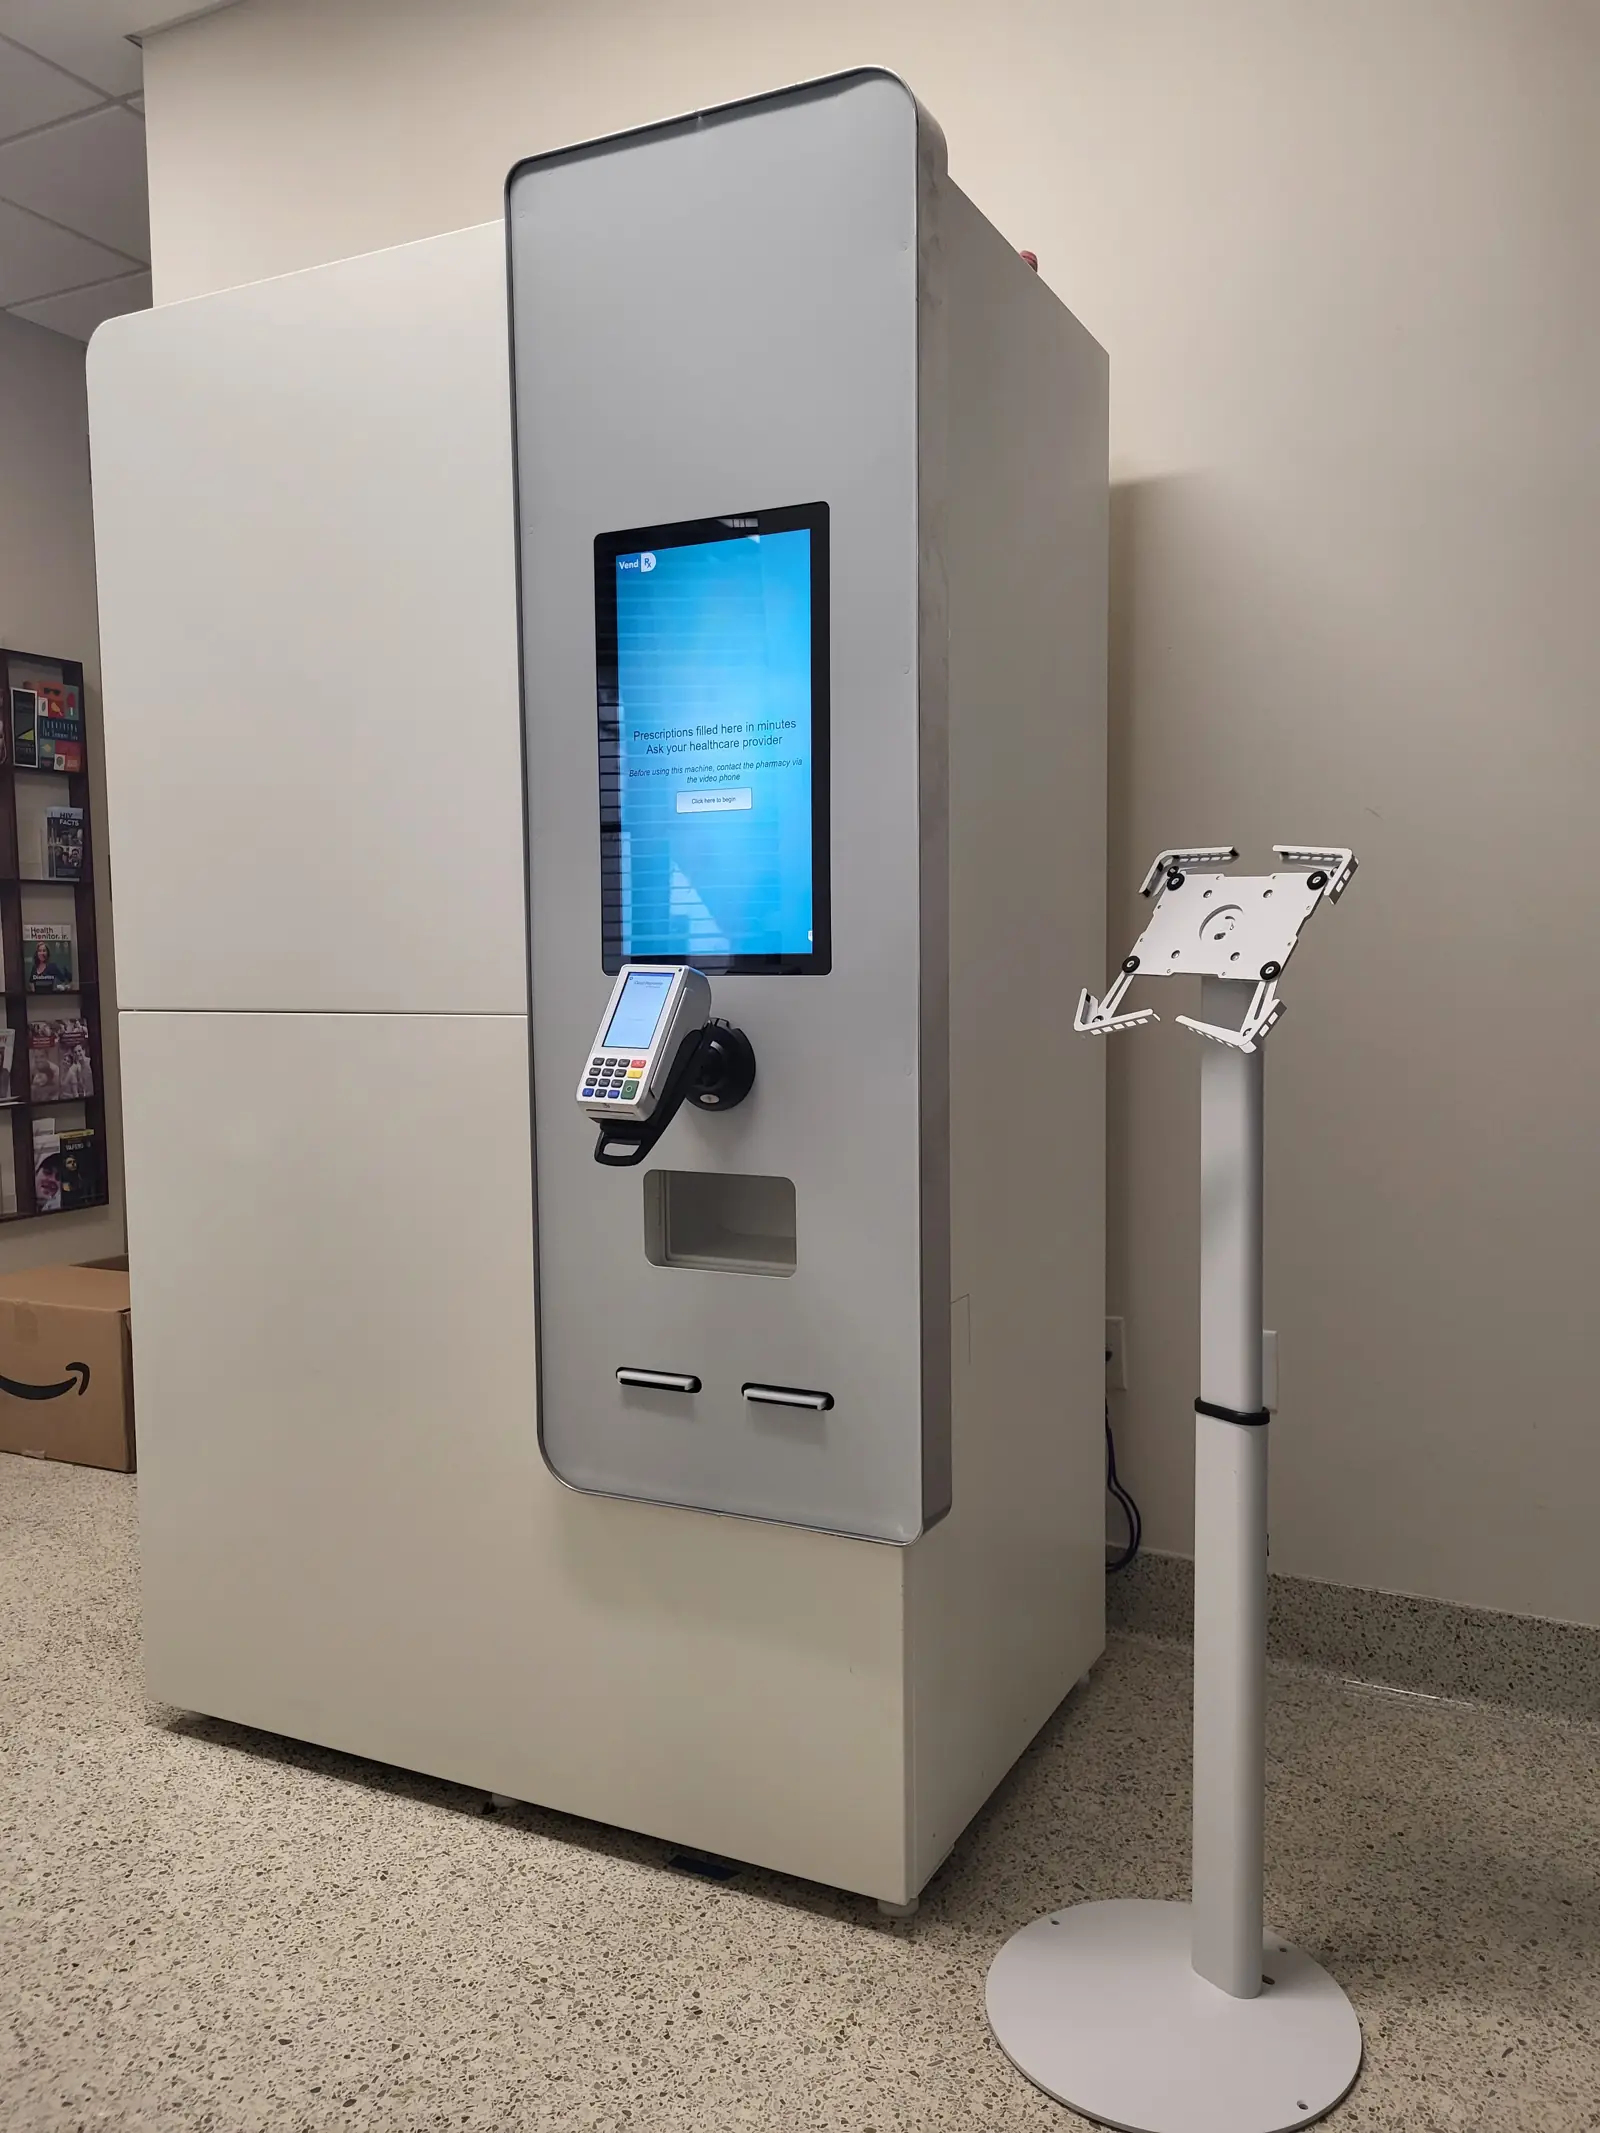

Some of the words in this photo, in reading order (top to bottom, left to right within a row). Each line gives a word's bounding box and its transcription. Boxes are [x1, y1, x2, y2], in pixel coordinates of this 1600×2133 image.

[619, 558, 639, 570] Vend
[633, 727, 694, 742] Prescriptions
[696, 724, 718, 737] filled
[721, 722, 743, 735] here
[745, 721, 754, 733] in
[757, 719, 797, 732] minutes
[646, 741, 664, 755] Ask
[666, 743, 687, 755] your
[689, 739, 740, 752] healthcare
[742, 735, 783, 750] provider
[629, 767, 651, 777] Before
[652, 766, 670, 777] using
[671, 765, 683, 775] this
[684, 763, 715, 774] machine,
[716, 762, 742, 772] contact
[743, 761, 755, 770] the
[755, 759, 791, 770] pharmacy
[792, 757, 803, 767] via
[686, 775, 698, 784] the
[699, 774, 718, 783] video
[719, 773, 741, 784] phone
[691, 797, 704, 805] Click
[704, 796, 716, 804] here
[722, 796, 737, 804] begin
[59, 819, 79, 827] FACTS
[30, 926, 54, 934] Health
